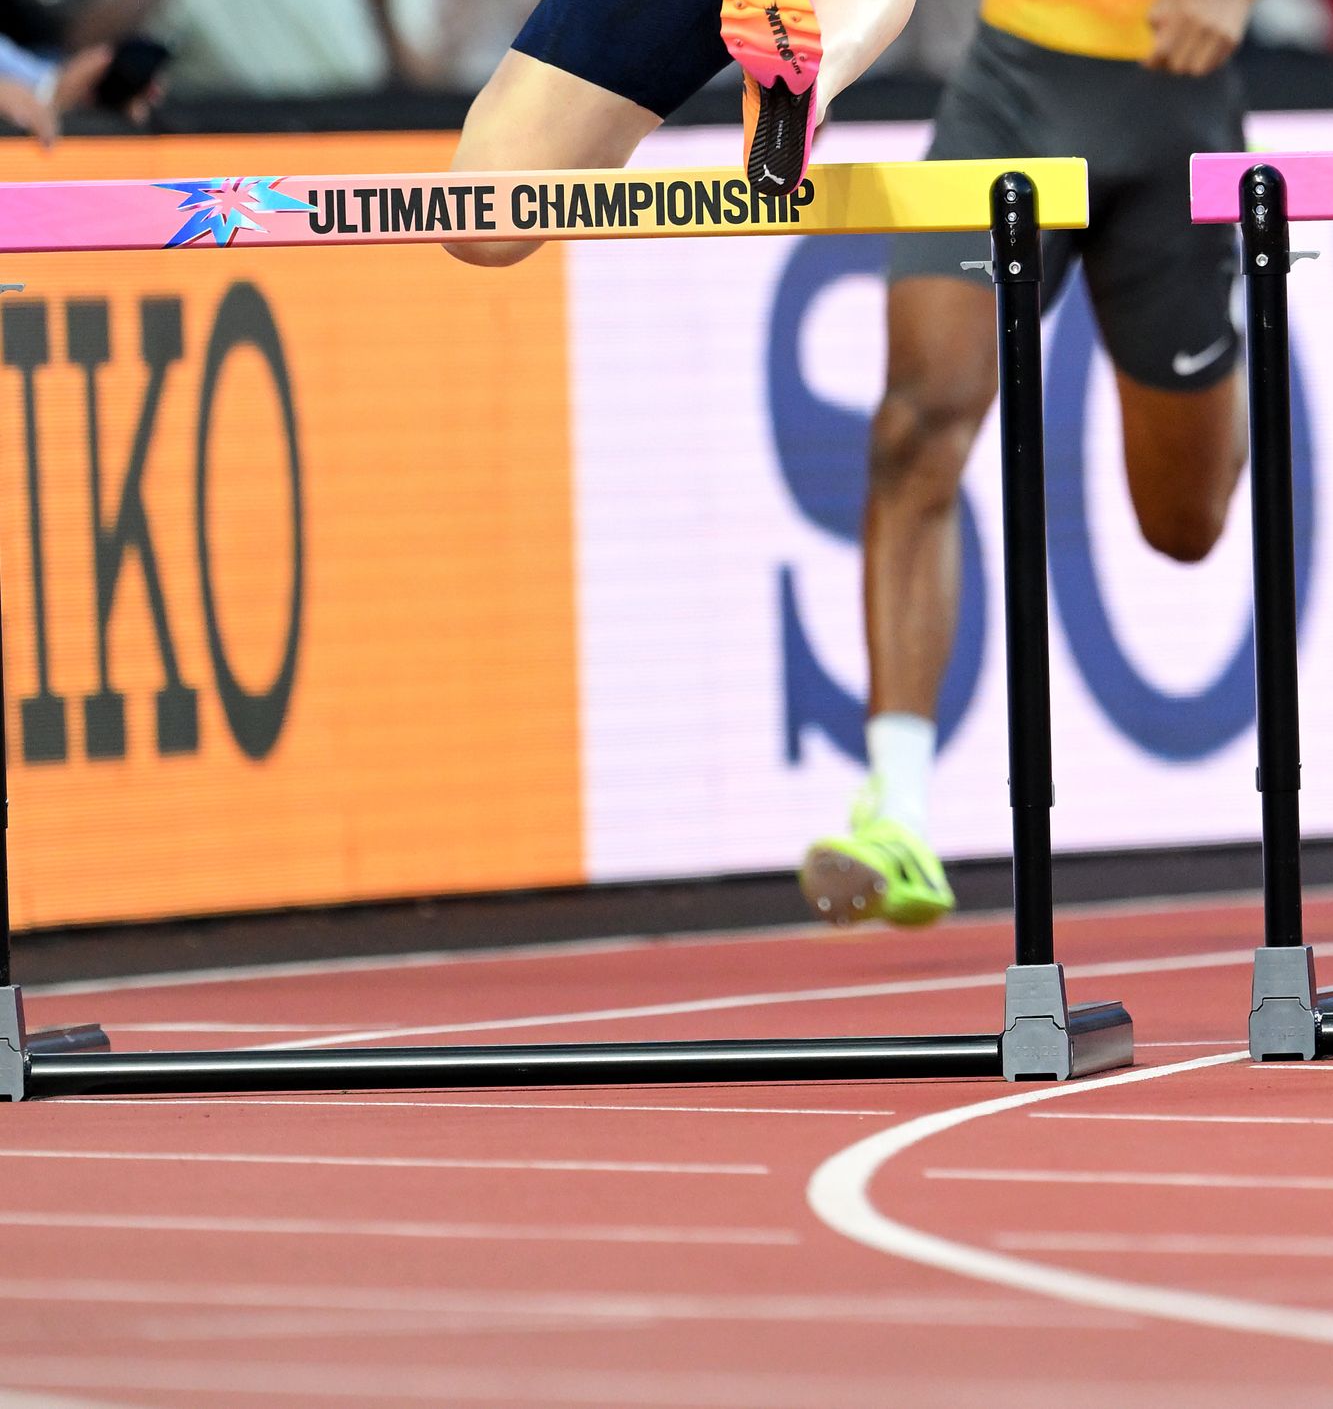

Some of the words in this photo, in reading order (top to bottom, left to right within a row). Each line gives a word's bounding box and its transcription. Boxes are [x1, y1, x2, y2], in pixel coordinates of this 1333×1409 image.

[308, 185, 497, 235] ULTIMATE
[511, 178, 815, 230] CHAMPIONSHIP
[0, 280, 306, 762] IKO
